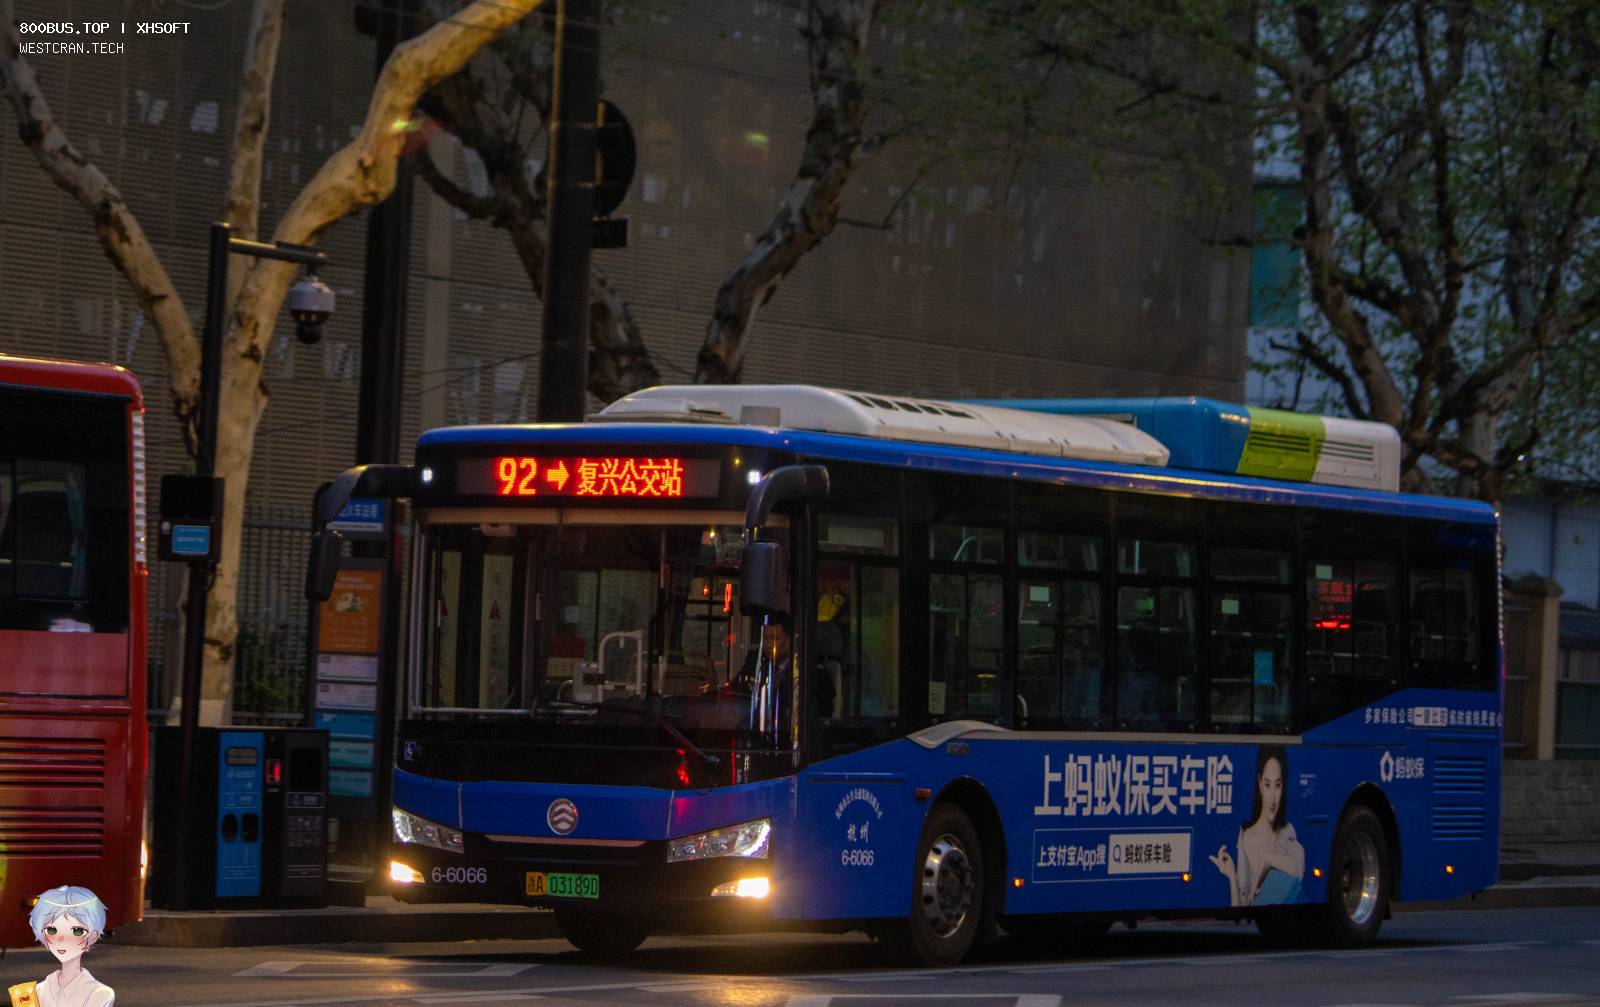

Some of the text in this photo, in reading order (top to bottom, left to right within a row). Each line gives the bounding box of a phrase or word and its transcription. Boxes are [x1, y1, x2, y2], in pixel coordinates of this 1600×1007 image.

[499, 457, 684, 496] 92 复兴公交站
[1034, 753, 1234, 817] 上蚂蚁保买车险
[842, 849, 874, 866] 6-6066
[431, 866, 488, 884] 6-6066
